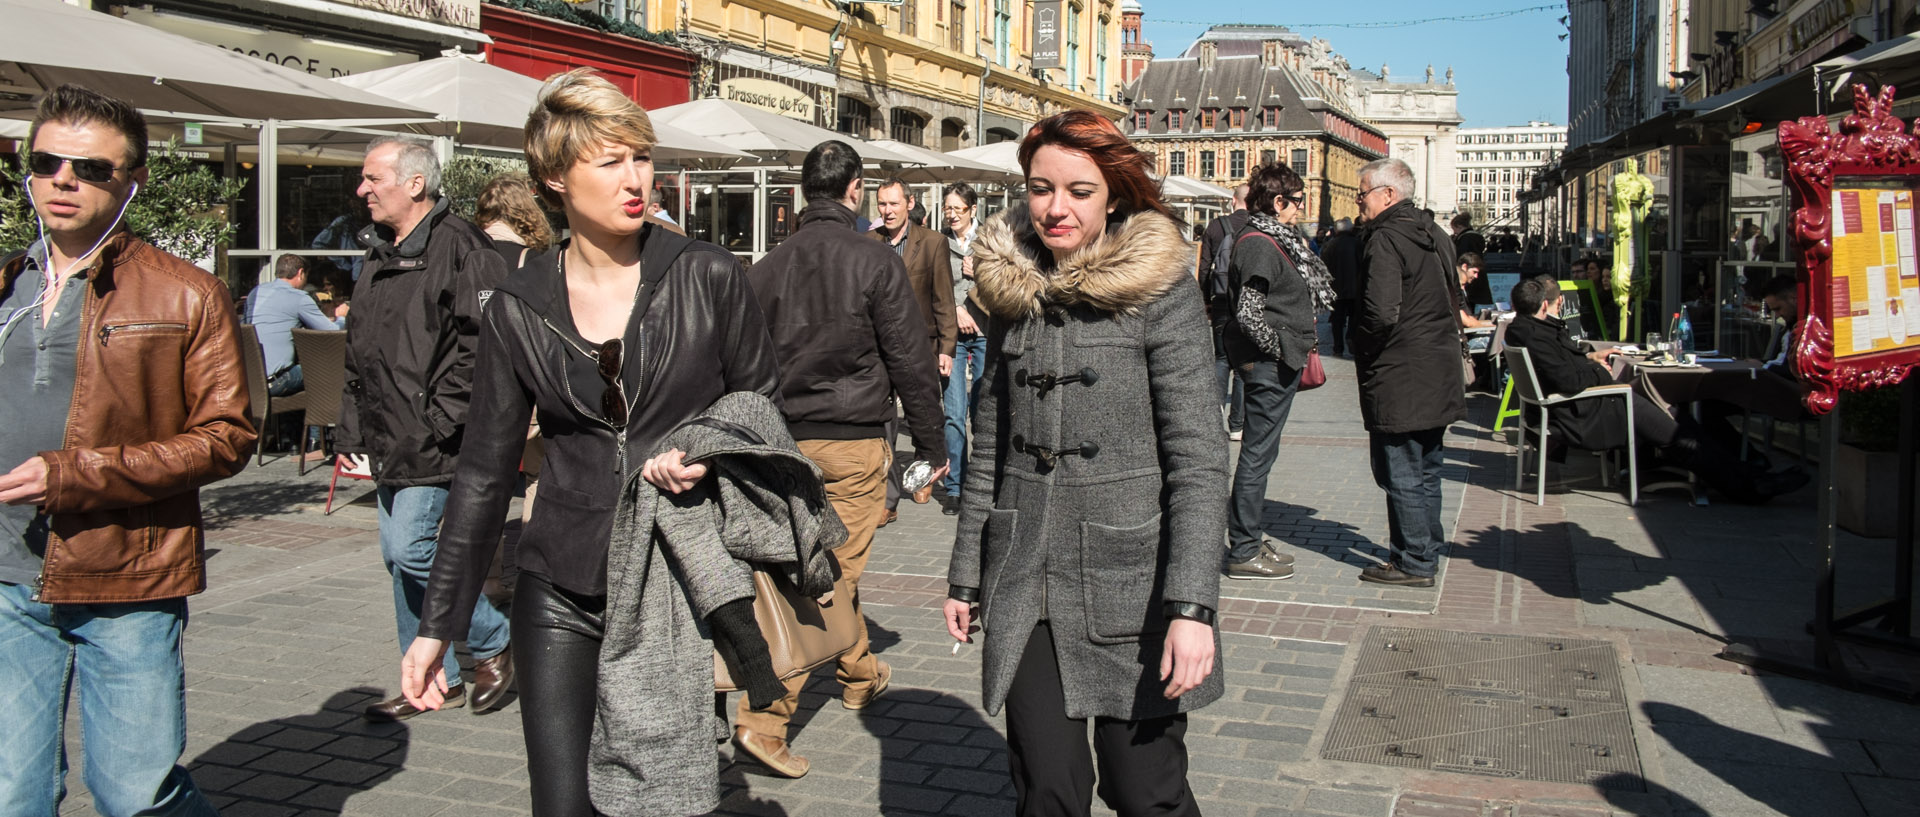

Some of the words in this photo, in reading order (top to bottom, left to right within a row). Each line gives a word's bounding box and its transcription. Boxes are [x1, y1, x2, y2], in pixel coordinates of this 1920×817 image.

[728, 85, 776, 108] Brasserie
[780, 96, 790, 111] de
[793, 98, 809, 117] Foy
